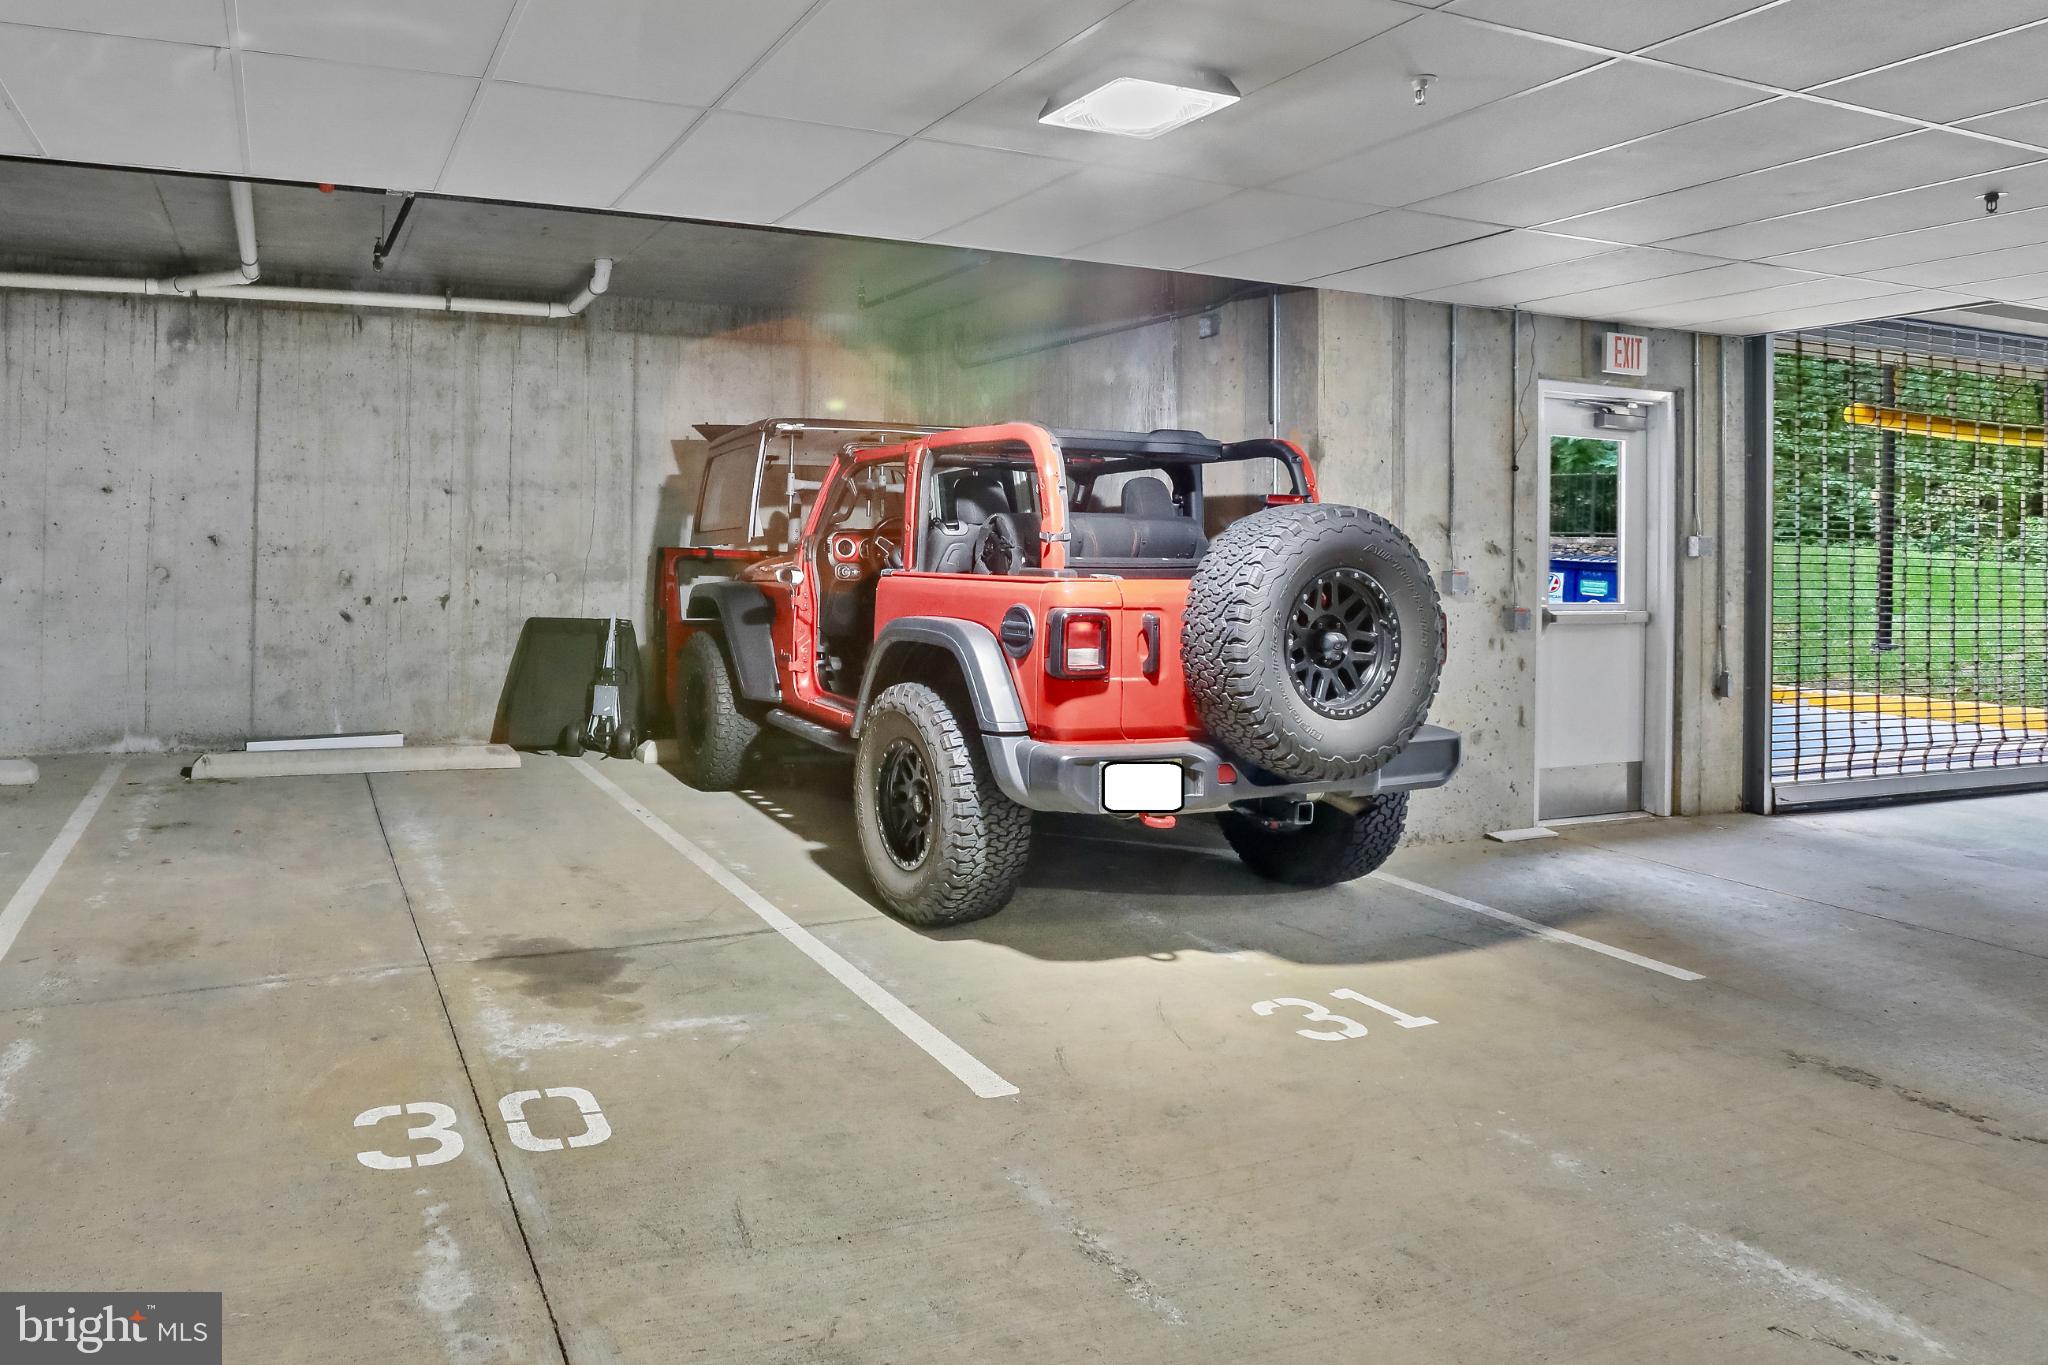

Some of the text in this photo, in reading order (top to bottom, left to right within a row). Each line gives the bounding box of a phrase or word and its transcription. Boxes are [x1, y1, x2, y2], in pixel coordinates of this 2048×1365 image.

[1614, 335, 1643, 370] EXIT
[1251, 988, 1439, 1041] 31
[353, 1086, 612, 1170] 30
